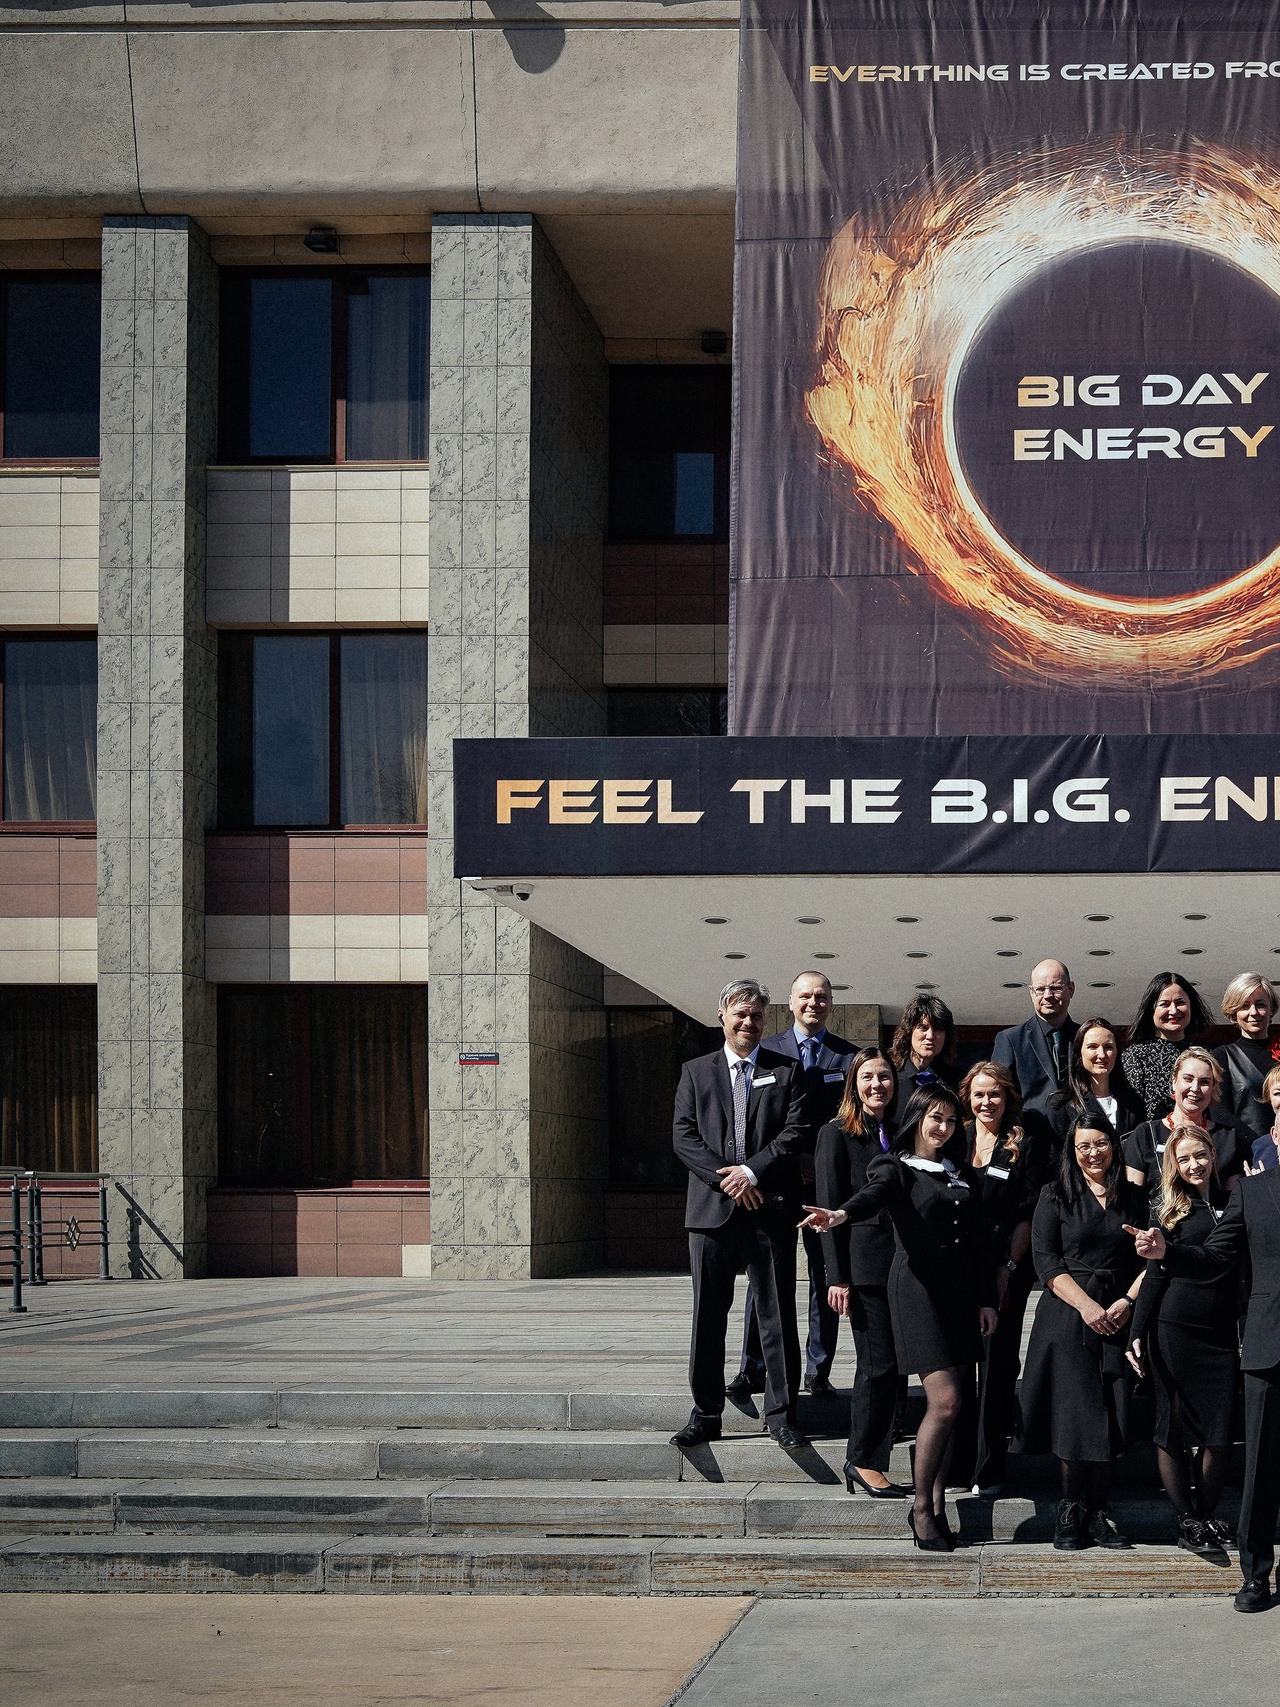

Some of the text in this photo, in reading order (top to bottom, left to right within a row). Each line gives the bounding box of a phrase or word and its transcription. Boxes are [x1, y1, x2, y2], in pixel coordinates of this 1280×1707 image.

[809, 65, 1008, 83] EVERITHING
[1019, 64, 1051, 82] IS
[1060, 62, 1215, 81] CREATED
[1017, 373, 1269, 407] BIG DAY
[1013, 426, 1275, 460] ENERGY
[496, 779, 705, 825] FEEL
[730, 778, 903, 824] THE
[930, 777, 1131, 824] B.I.G.
